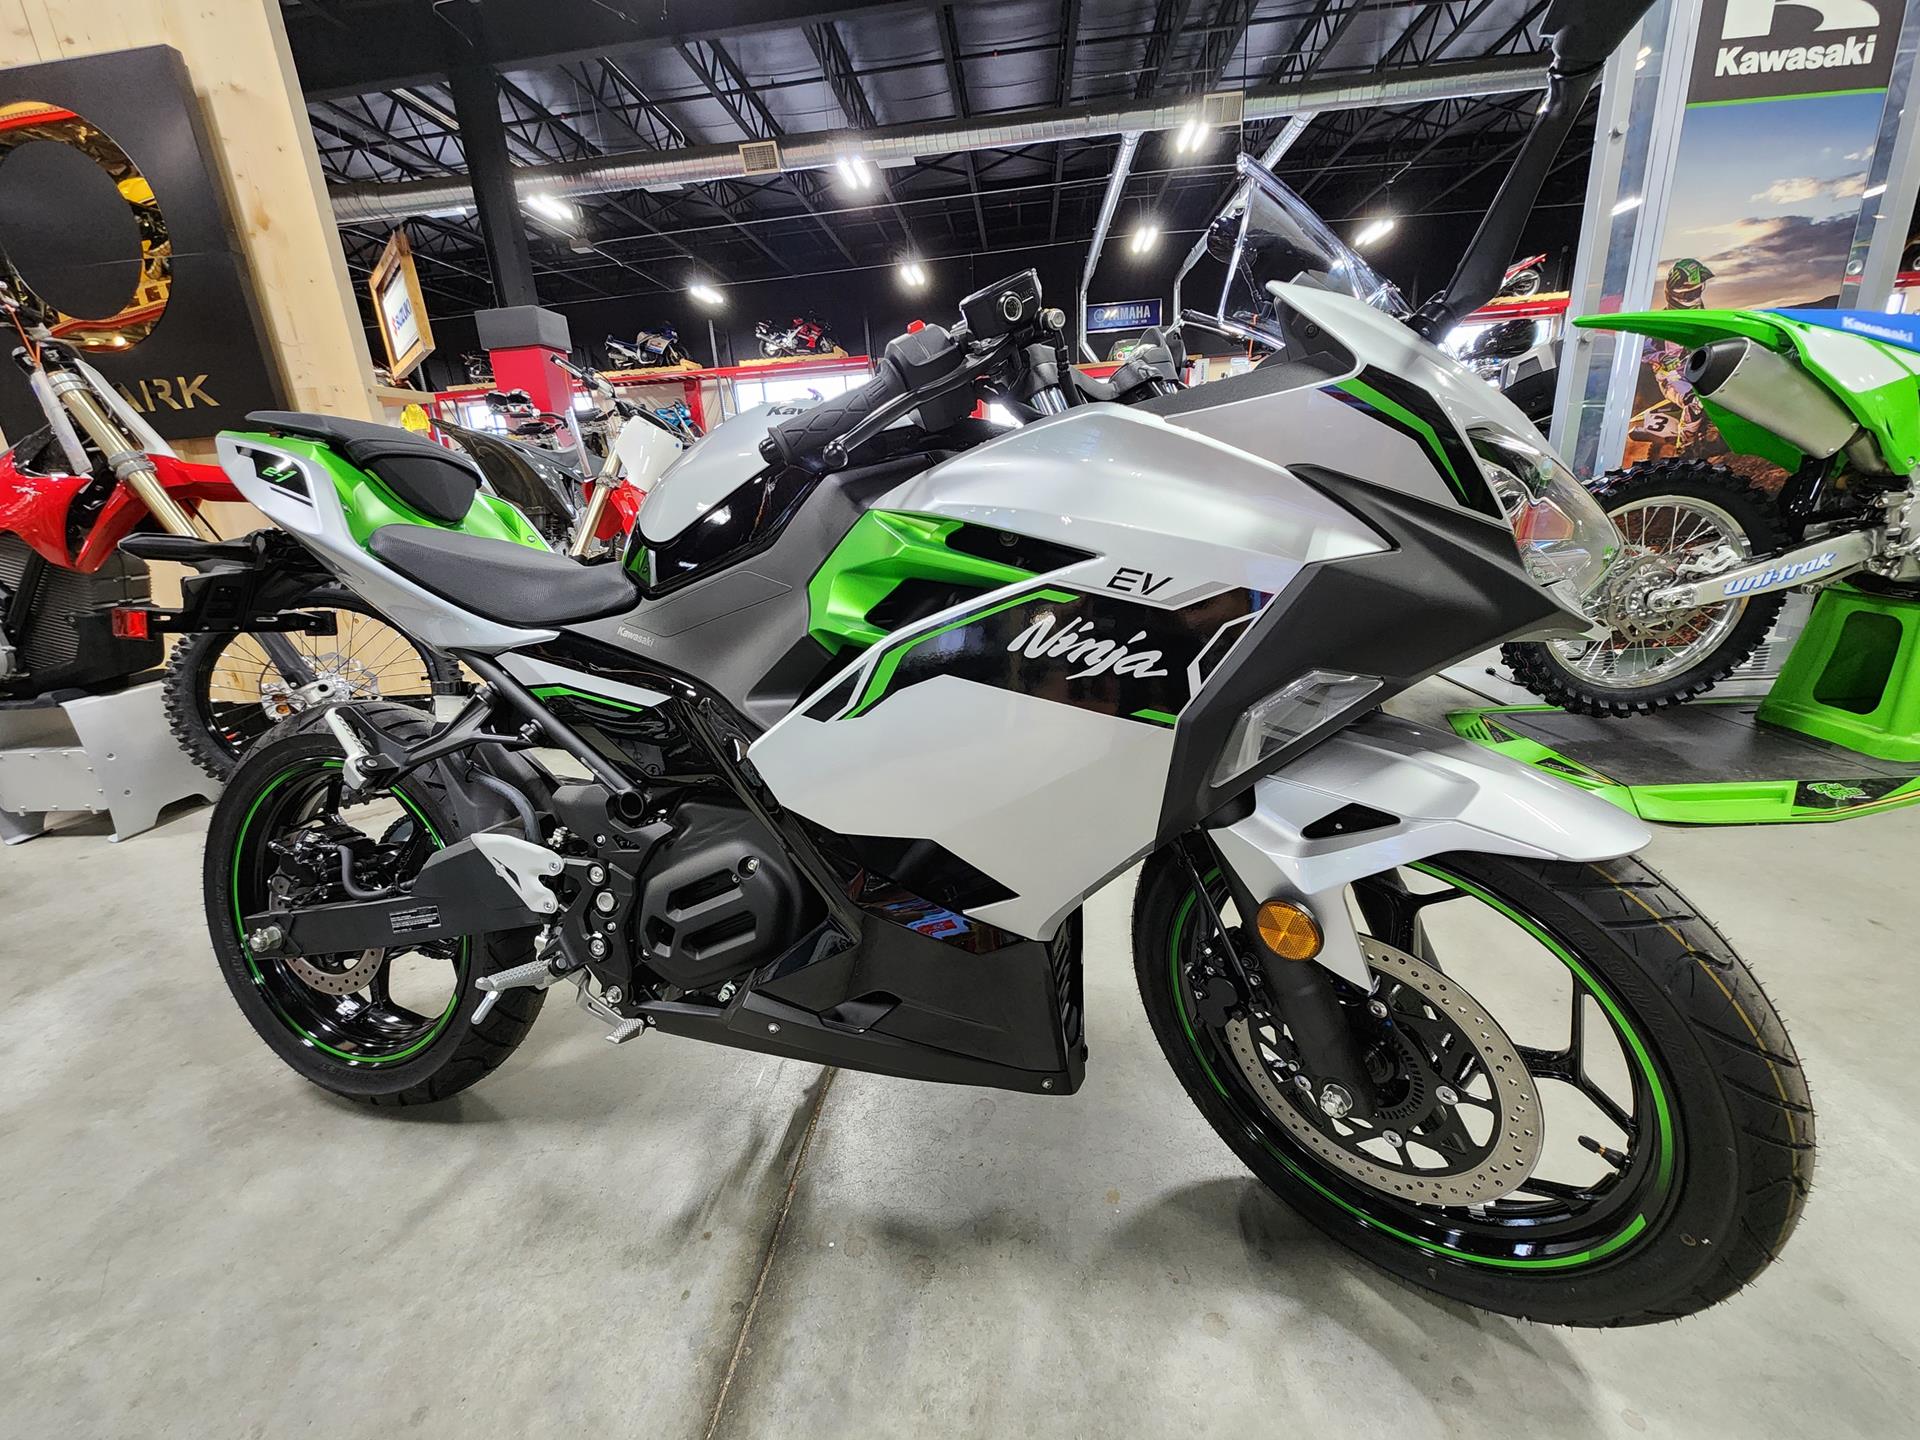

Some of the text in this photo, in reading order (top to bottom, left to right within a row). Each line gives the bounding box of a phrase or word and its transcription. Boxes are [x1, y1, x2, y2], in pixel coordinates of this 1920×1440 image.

[1714, 34, 1878, 78] Kawasaki
[1107, 304, 1151, 321] YAMAHA
[1841, 316, 1914, 343] Kawasaki
[1647, 415, 1669, 432] 3
[1106, 566, 1174, 596] EV
[1723, 552, 1837, 596] uni-trak
[616, 626, 656, 648] Kawasaki
[1006, 610, 1169, 681] Ninja
